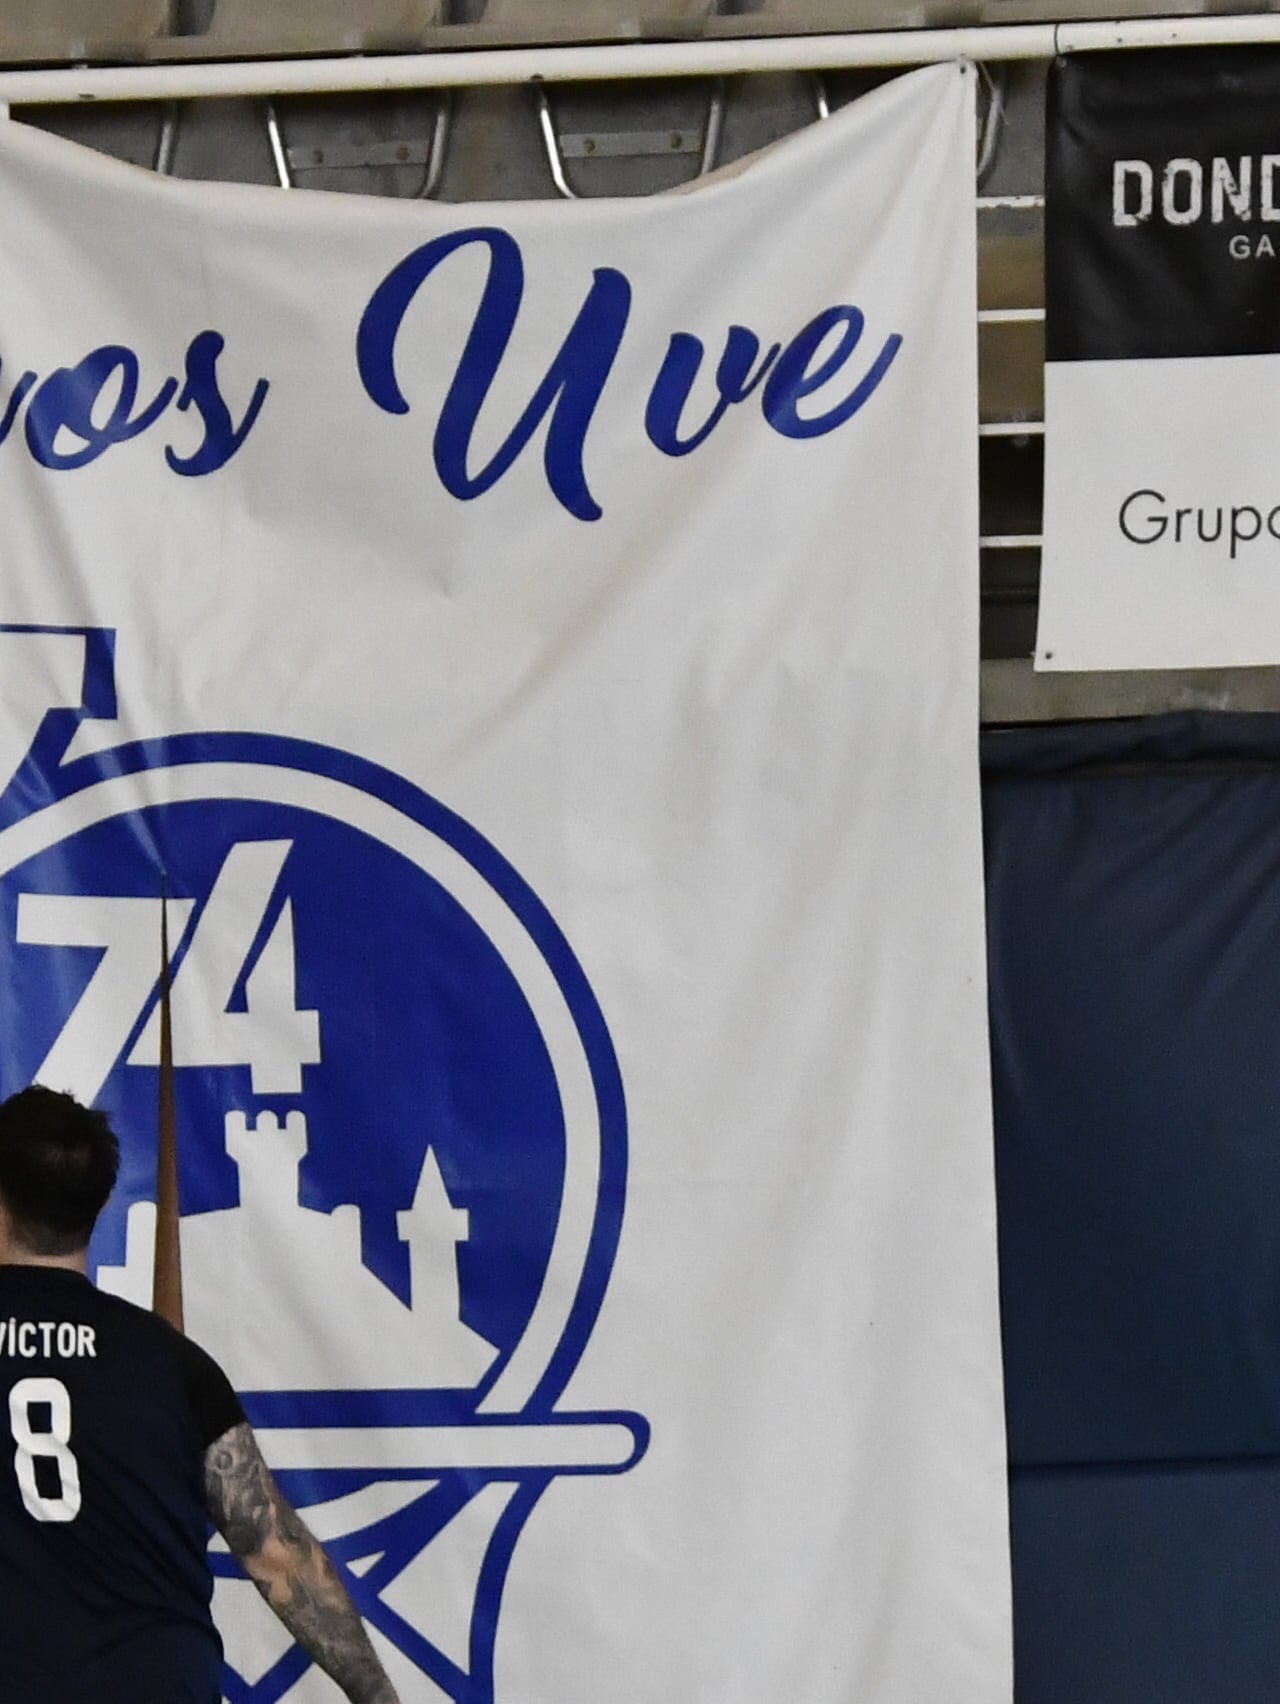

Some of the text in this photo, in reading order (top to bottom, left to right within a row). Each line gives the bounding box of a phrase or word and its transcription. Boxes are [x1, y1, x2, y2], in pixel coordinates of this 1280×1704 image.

[356, 227, 903, 523] Uve
[16, 838, 322, 1104] 74
[8, 1377, 82, 1523] 8
